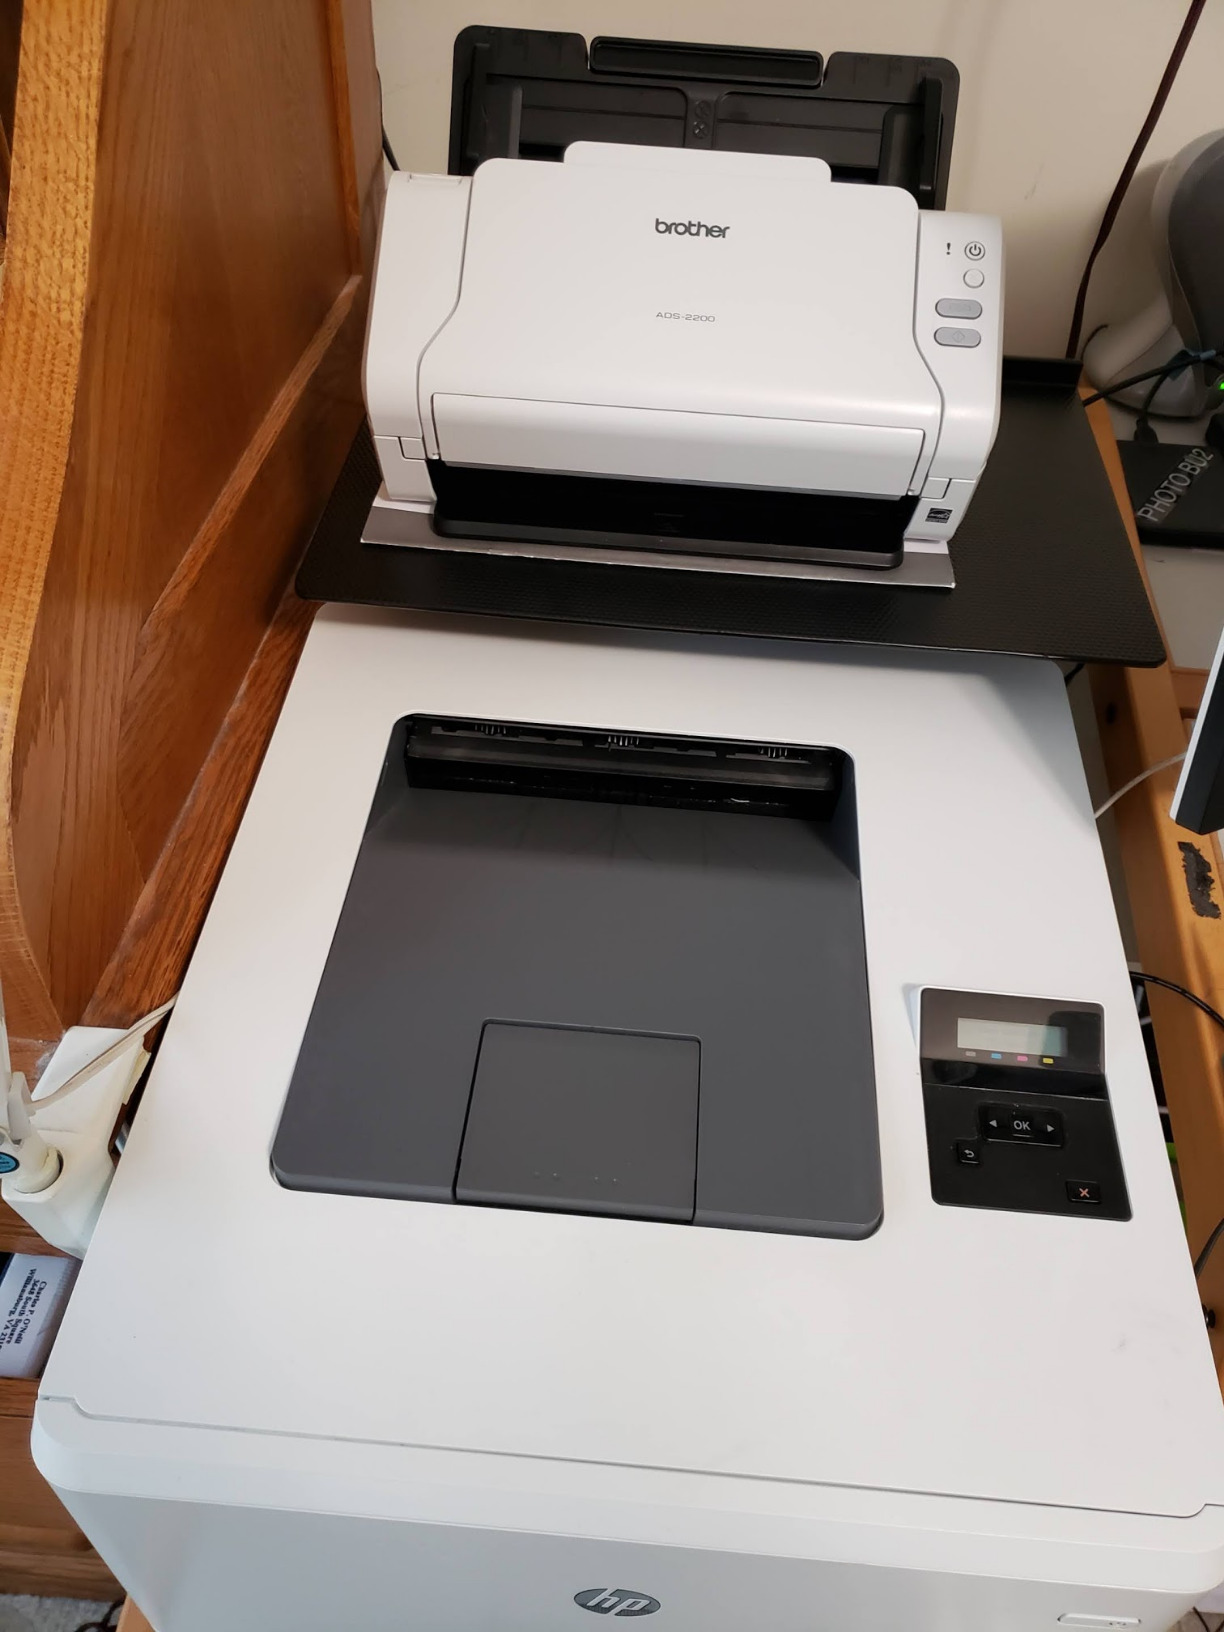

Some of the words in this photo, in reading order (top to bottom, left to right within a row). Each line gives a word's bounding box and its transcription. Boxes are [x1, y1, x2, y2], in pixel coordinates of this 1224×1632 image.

[655, 218, 730, 238] brother
[655, 312, 716, 323] ADS-2200
[1136, 473, 1191, 522] PHOTO
[1013, 1120, 1031, 1132] OK
[31, 1281, 47, 1308] Charles
[18, 1296, 32, 1317] South
[3, 1319, 14, 1331] VA
[6, 1318, 22, 1345] Square
[585, 1588, 651, 1615] hp
